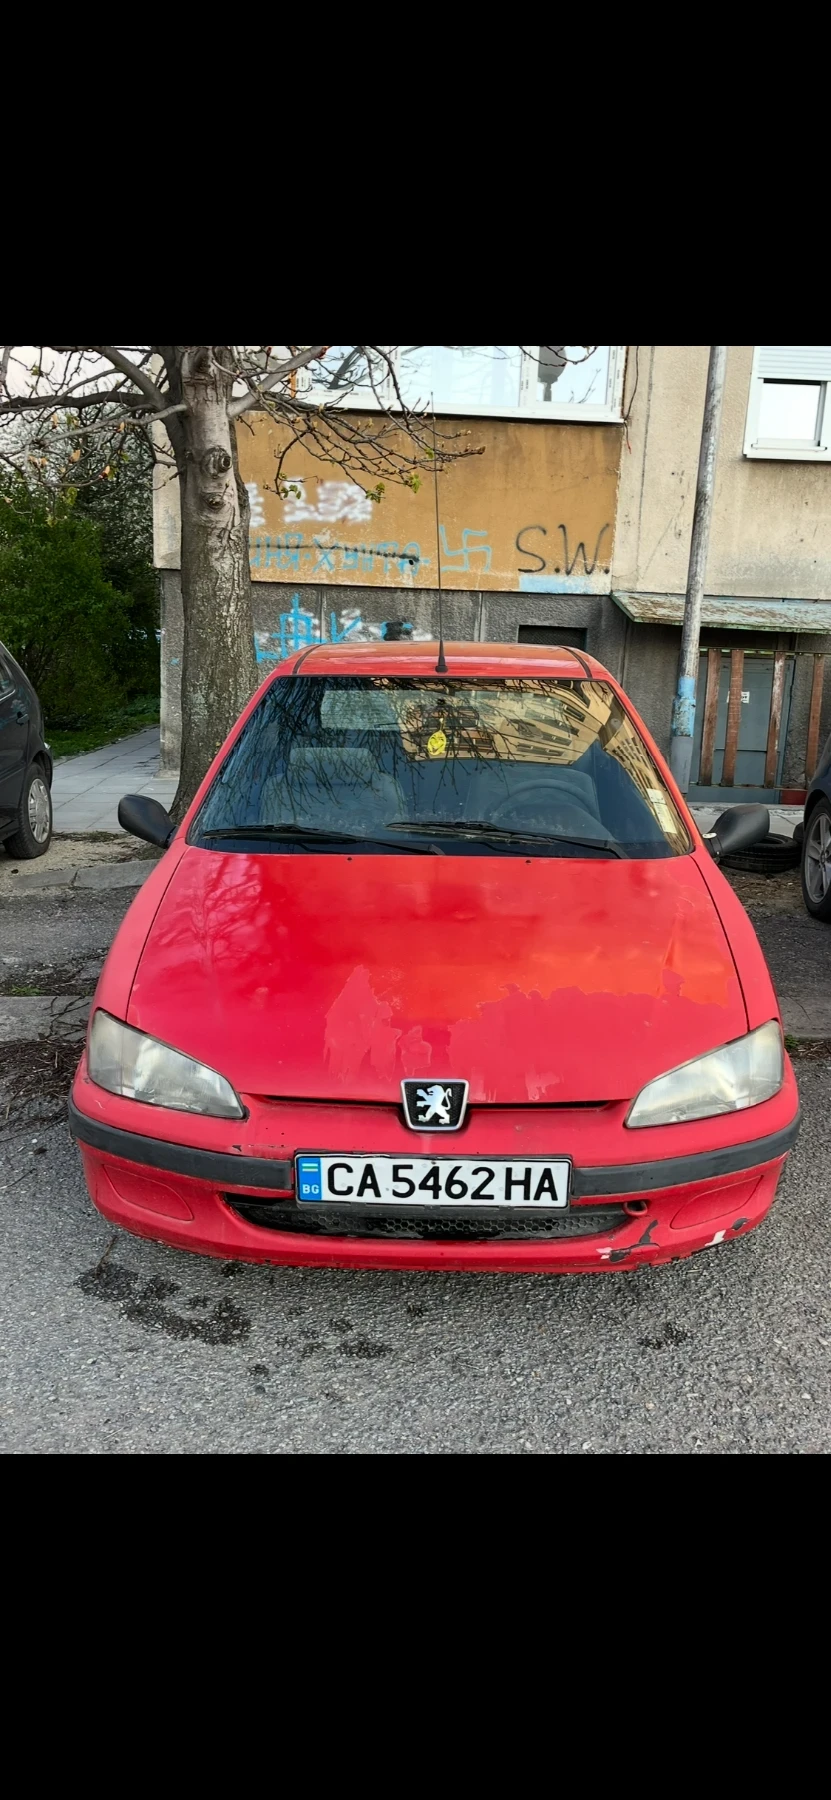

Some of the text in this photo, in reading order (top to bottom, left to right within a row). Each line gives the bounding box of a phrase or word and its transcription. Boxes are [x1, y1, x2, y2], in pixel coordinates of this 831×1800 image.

[302, 1184, 320, 1194] BG
[327, 1162, 559, 1201] CA 5462 HA
